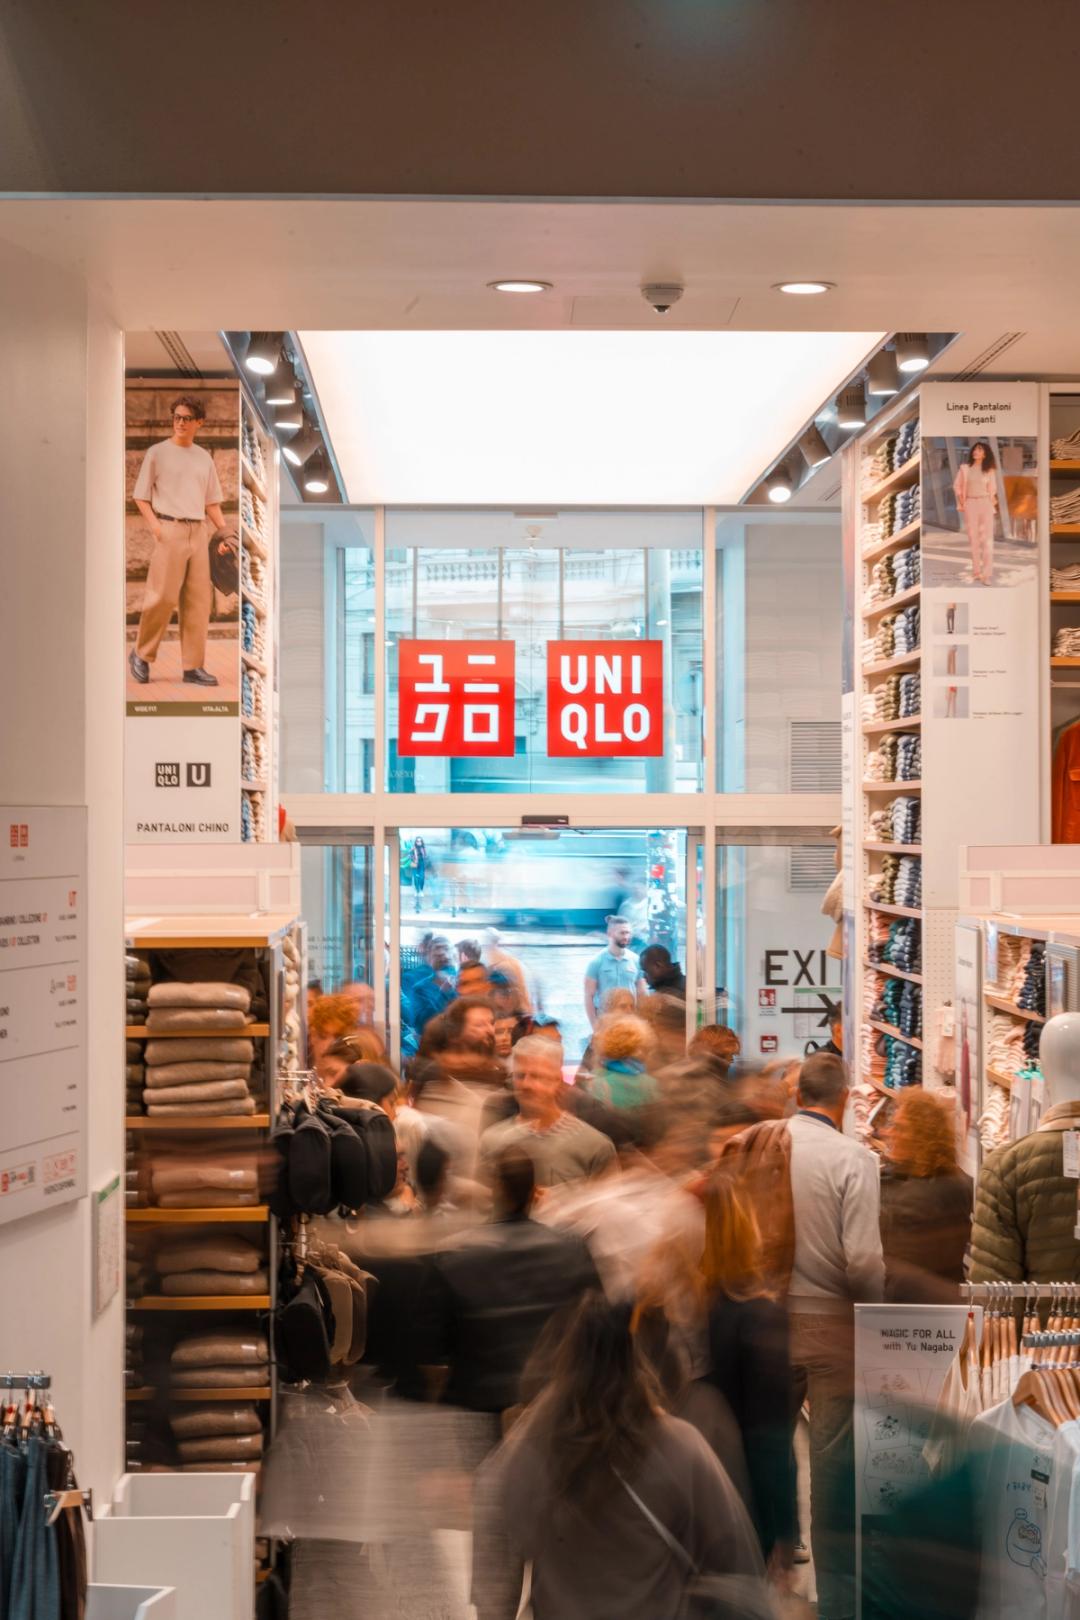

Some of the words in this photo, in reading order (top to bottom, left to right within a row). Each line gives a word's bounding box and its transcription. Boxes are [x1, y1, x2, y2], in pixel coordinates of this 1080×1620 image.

[946, 402, 969, 411] Linea
[972, 402, 1012, 411] Pantaloni
[962, 415, 996, 425] Eleganti
[560, 655, 642, 694] UNI
[560, 703, 651, 750] QLO
[157, 765, 177, 775] UNI
[191, 764, 207, 785] U
[157, 775, 179, 786] QLO
[137, 823, 196, 832] PANTALONI
[198, 823, 229, 832] CHINO
[764, 949, 843, 986] EXI
[881, 1329, 908, 1338] MAGIC
[912, 1329, 932, 1339] FOR
[936, 1329, 956, 1339] ALL
[883, 1342, 901, 1351] with
[906, 1342, 917, 1351] Yu
[920, 1342, 954, 1353] Nagaba
